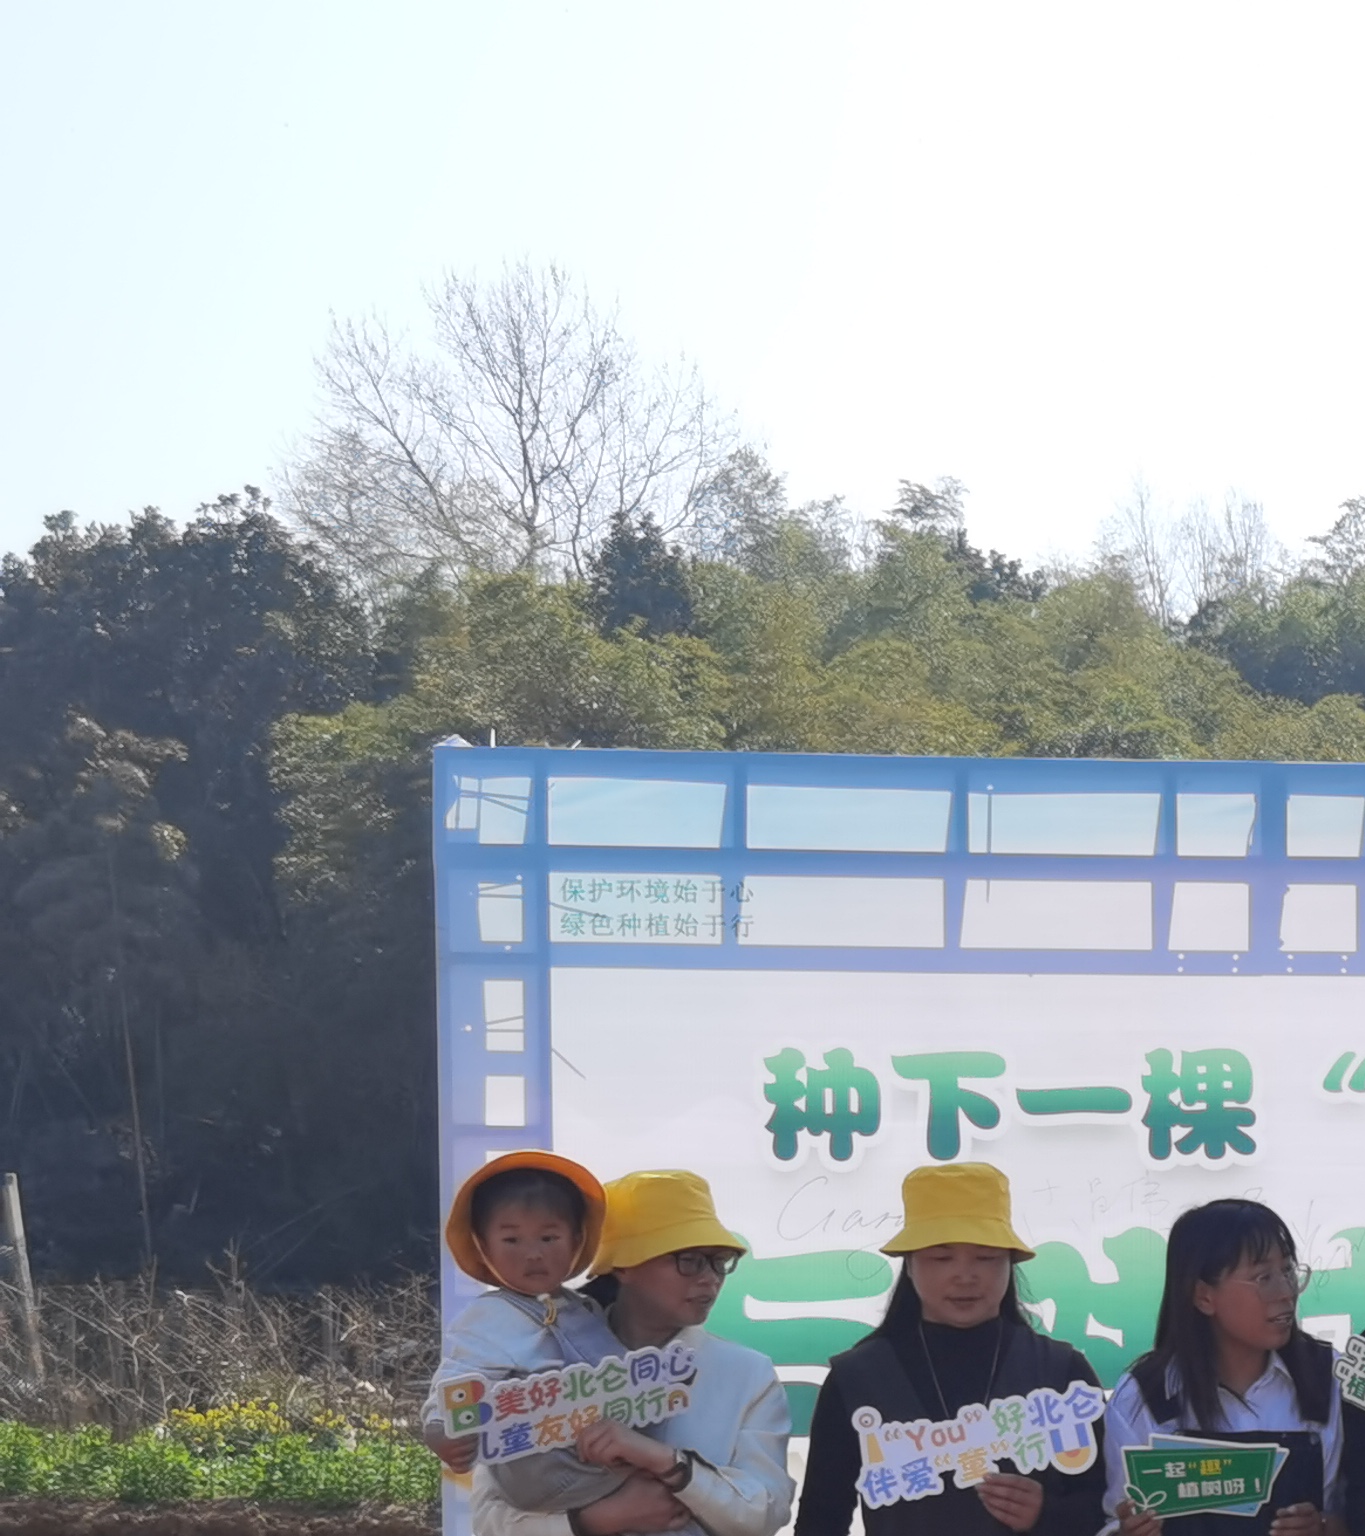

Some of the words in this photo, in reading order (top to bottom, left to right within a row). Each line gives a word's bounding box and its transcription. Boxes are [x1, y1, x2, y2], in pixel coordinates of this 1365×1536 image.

[560, 877, 755, 904] 保护环境始于心
[560, 912, 755, 938] 绿色种植始于行
[763, 1046, 1259, 1162] 种下一棵
[495, 1345, 698, 1424] 美好北仑同心
